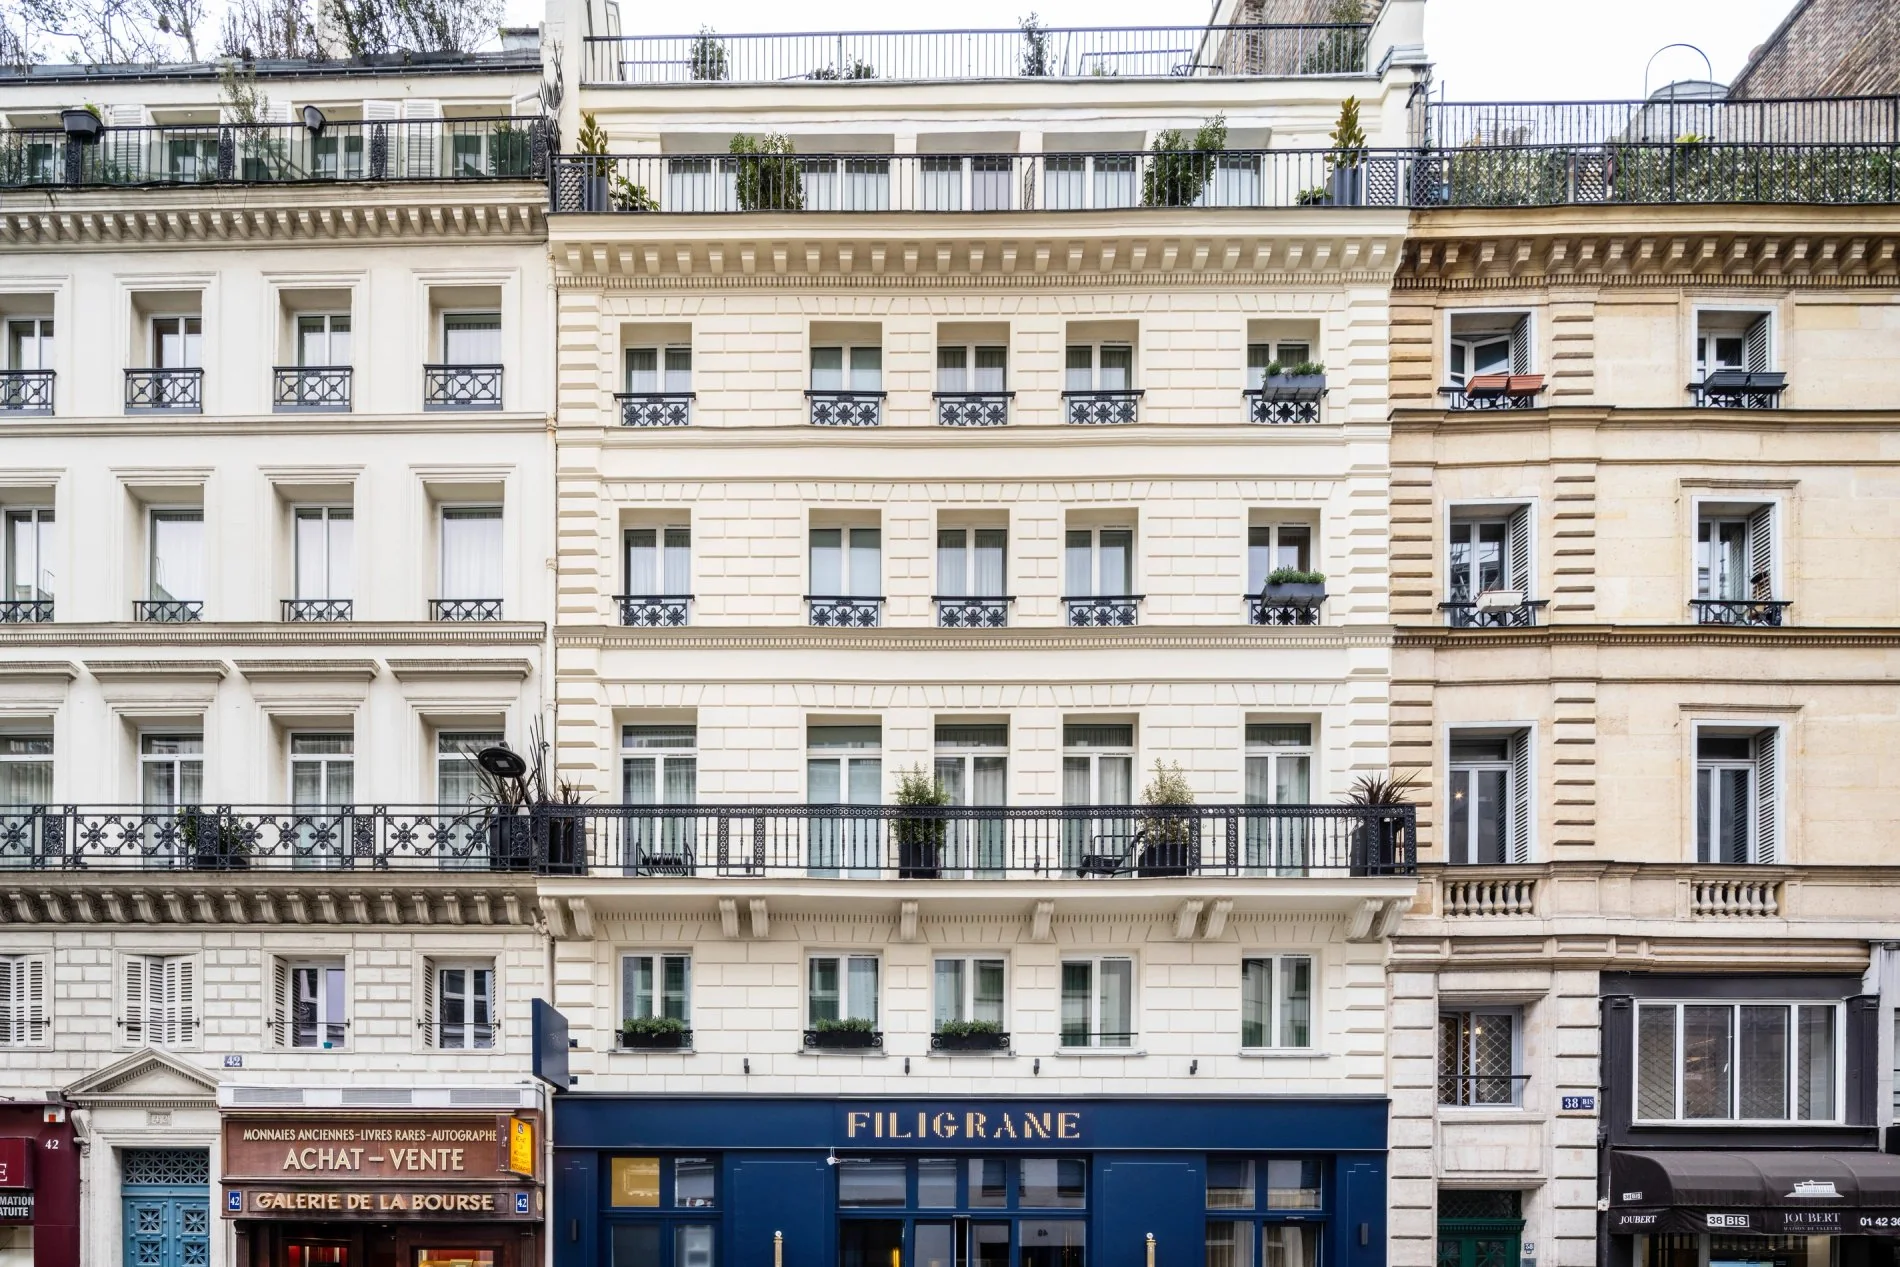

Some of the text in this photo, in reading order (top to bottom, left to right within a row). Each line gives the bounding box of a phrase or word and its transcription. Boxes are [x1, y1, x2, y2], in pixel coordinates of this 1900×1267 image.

[226, 1056, 240, 1066] 42
[1565, 1098, 1578, 1108] 38
[848, 1112, 1080, 1138] FILIGRANE
[243, 1129, 295, 1140] MONNAIES
[45, 1139, 59, 1150] 42
[283, 1148, 364, 1170] ACHAT
[389, 1148, 464, 1170] VENTE
[229, 1196, 240, 1206] 42
[255, 1193, 494, 1210] GALERIE DE LA BOURSE
[517, 1198, 527, 1208] 42
[1619, 1215, 1658, 1225] JOUBERT
[1709, 1216, 1746, 1225] 38 BIS
[1783, 1212, 1841, 1224] JOUBERT
[1860, 1217, 1872, 1226] 01
[1875, 1217, 1888, 1226] 42
